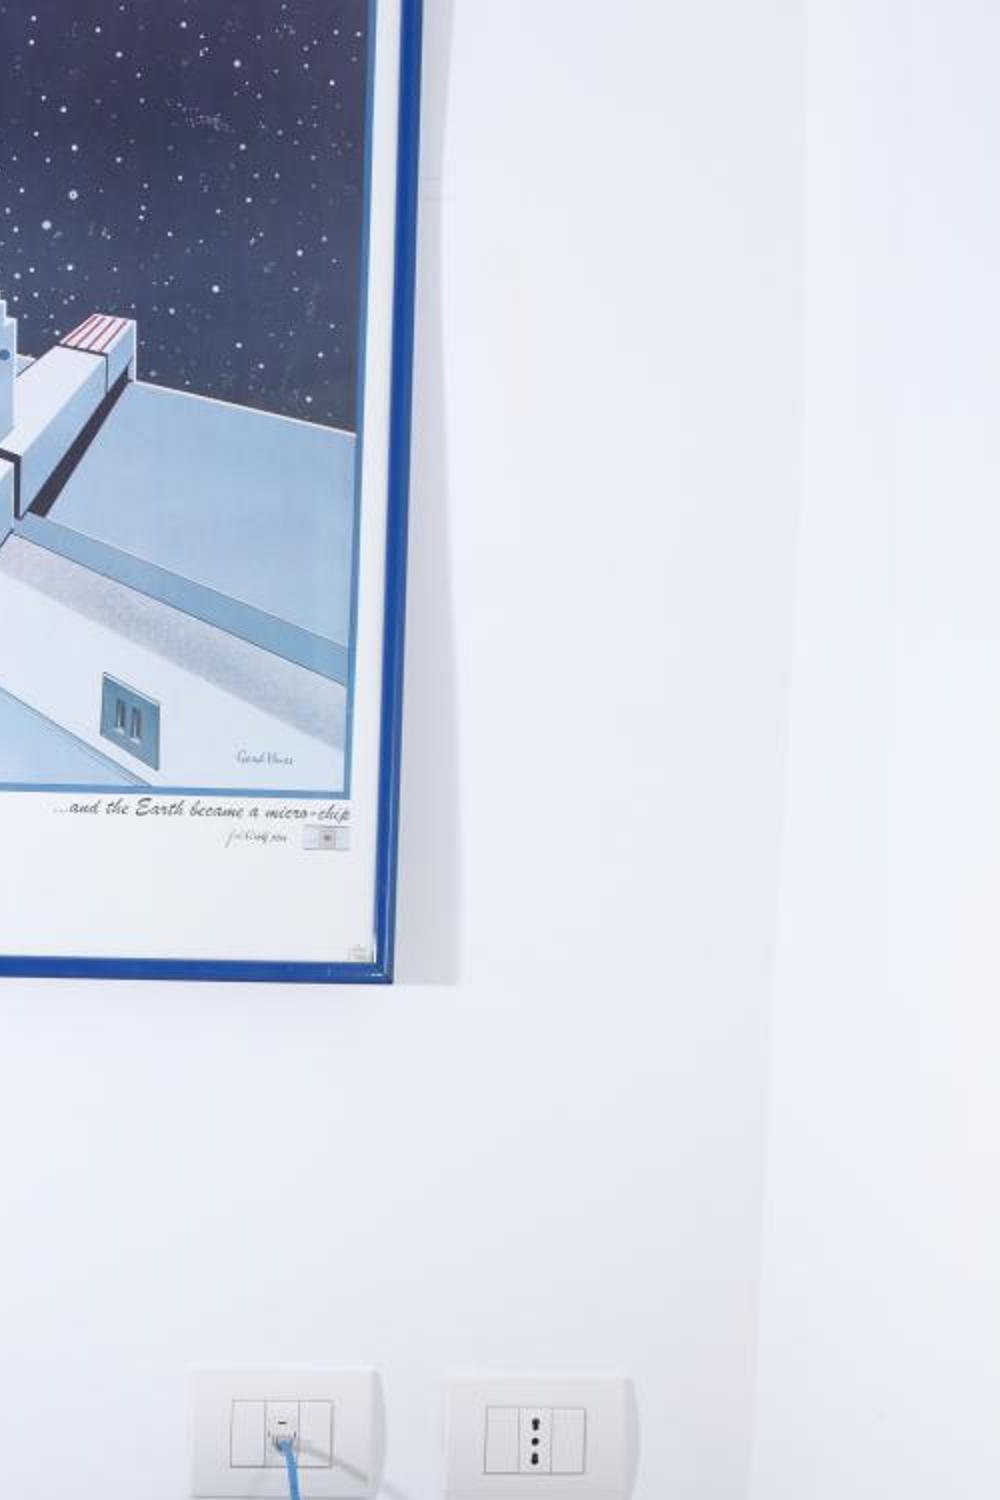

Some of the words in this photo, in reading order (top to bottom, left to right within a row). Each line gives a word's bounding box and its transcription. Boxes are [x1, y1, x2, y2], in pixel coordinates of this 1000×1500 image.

[106, 799, 129, 815] the
[136, 797, 184, 817] Earth
[190, 800, 244, 817] became
[249, 806, 259, 817] a
